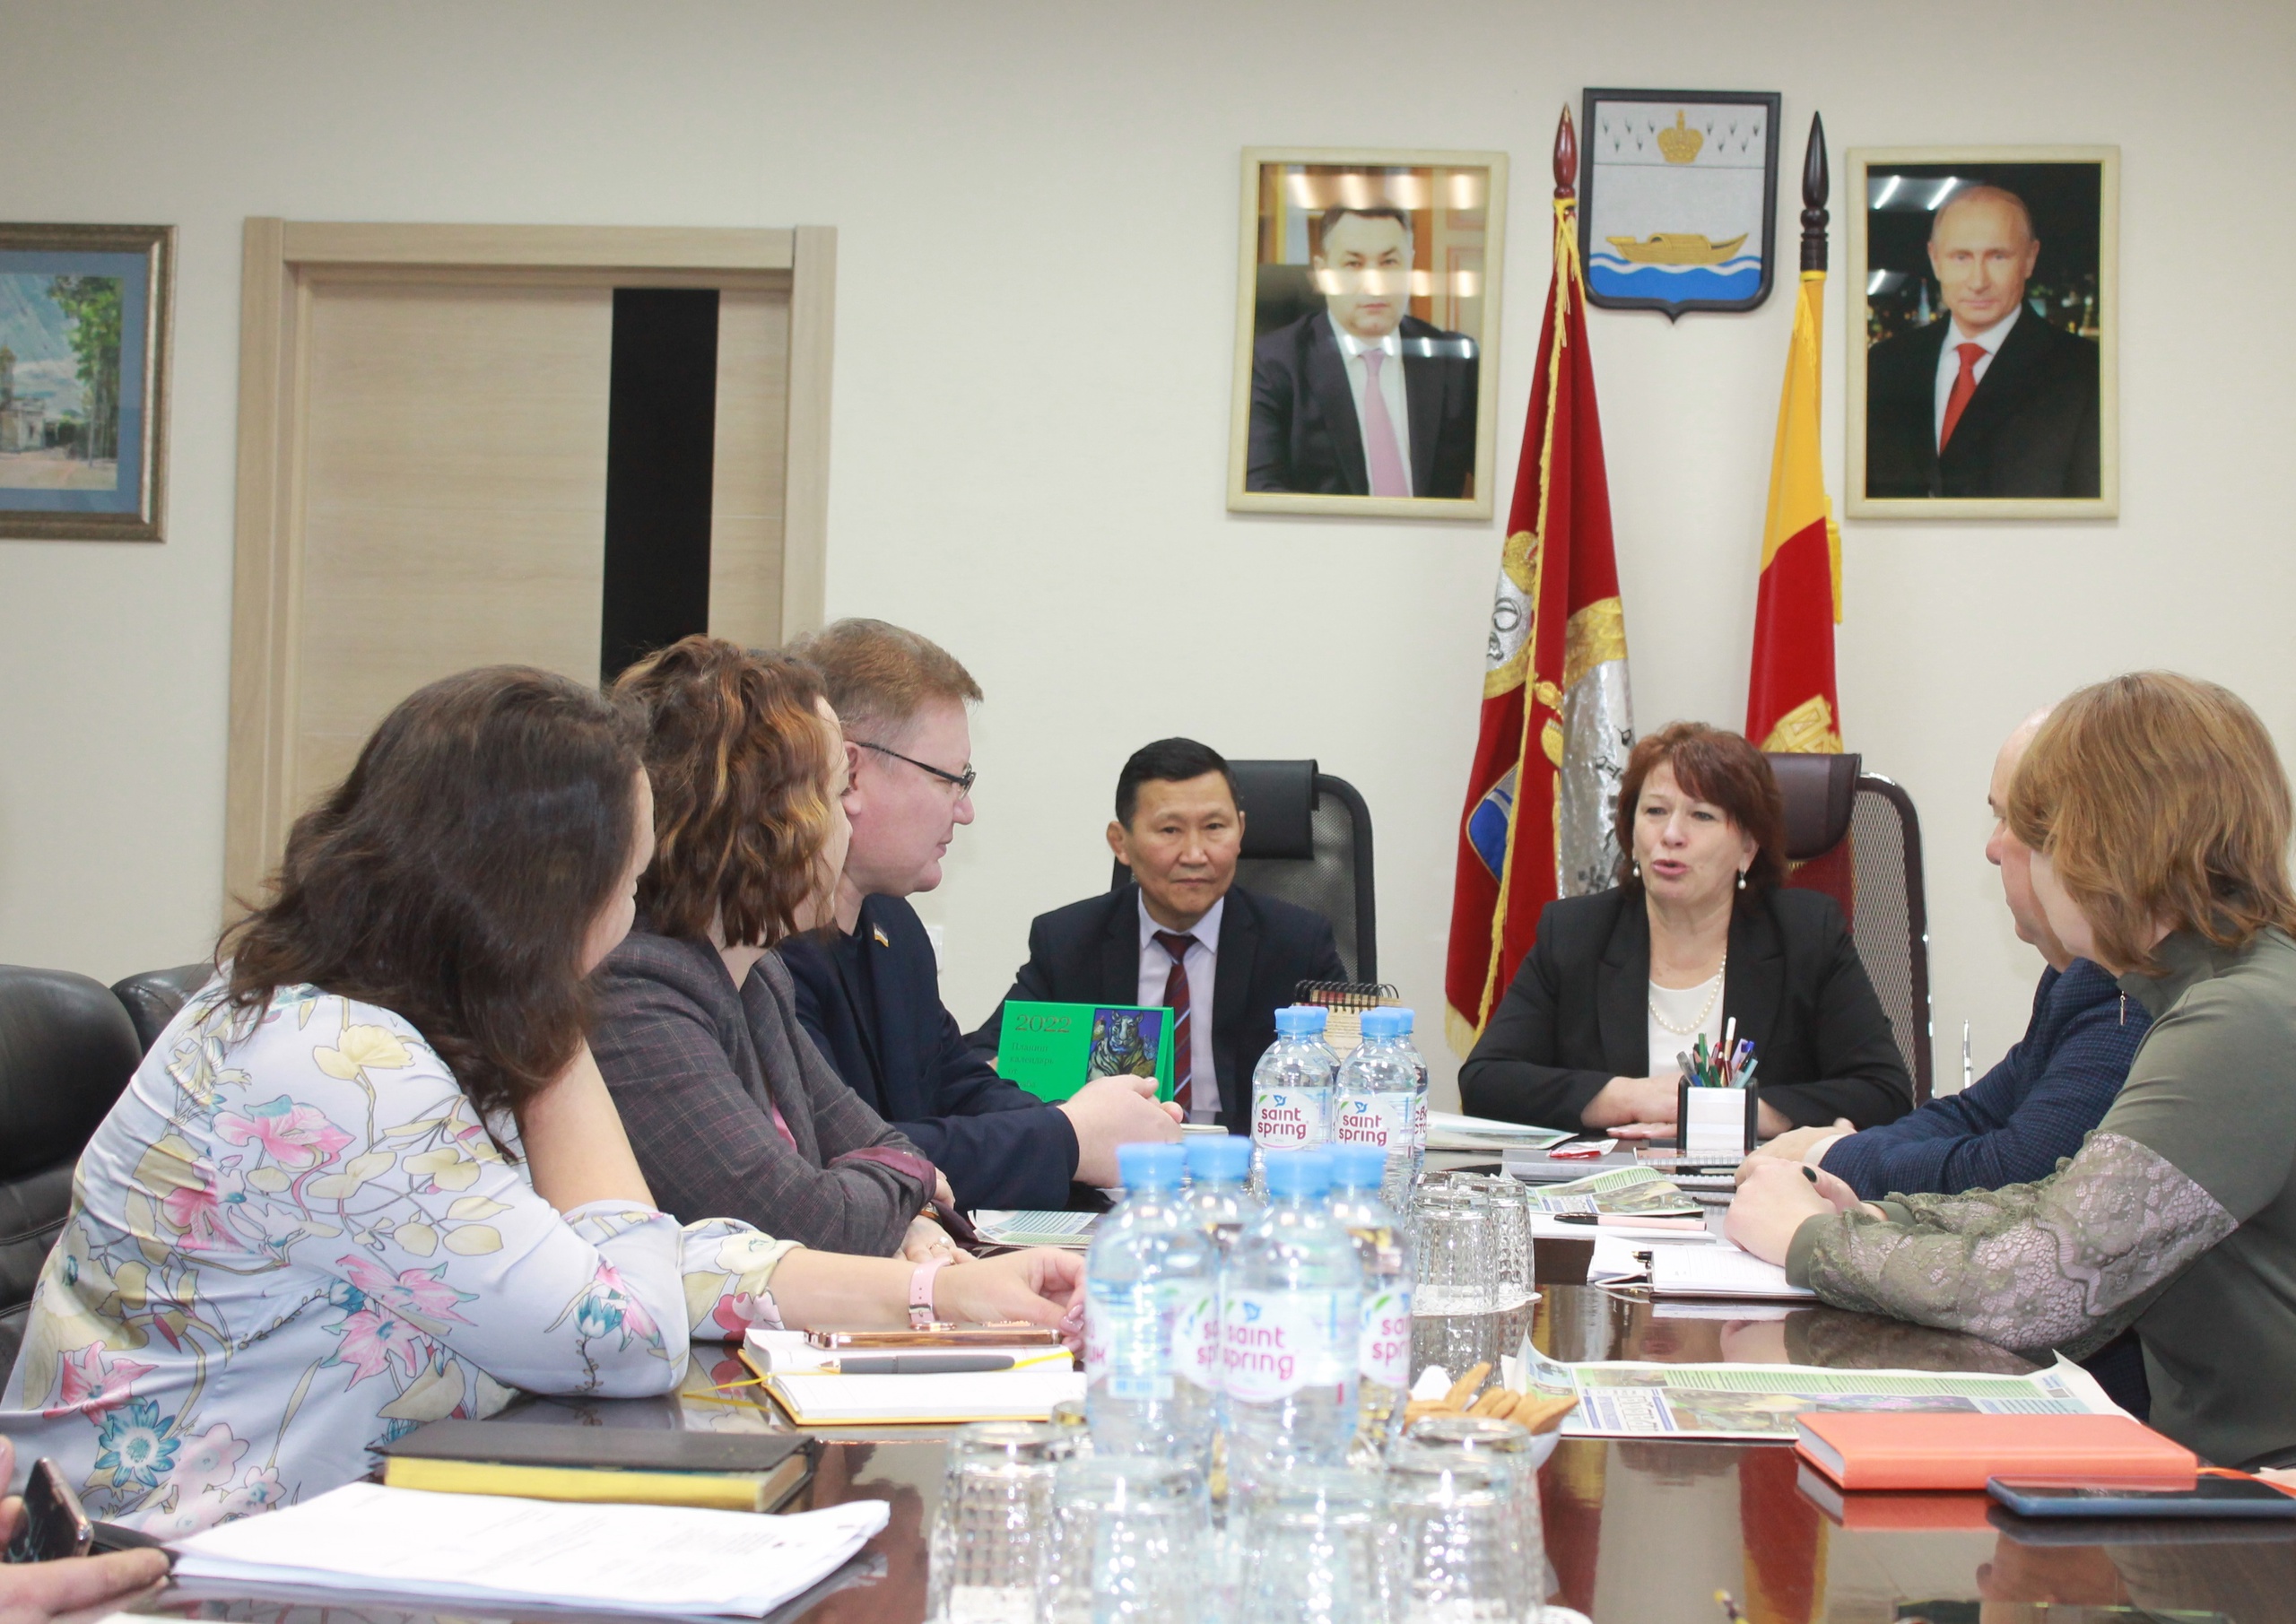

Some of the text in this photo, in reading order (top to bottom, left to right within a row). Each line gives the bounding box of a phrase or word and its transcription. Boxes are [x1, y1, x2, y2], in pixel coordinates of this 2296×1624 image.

[1014, 1013, 1072, 1033] 2022
[1009, 1055, 1055, 1066] календарь
[1261, 1107, 1302, 1121] saint
[1343, 1115, 1383, 1128] saint
[1257, 1122, 1307, 1140] spring
[1338, 1128, 1387, 1147] spring
